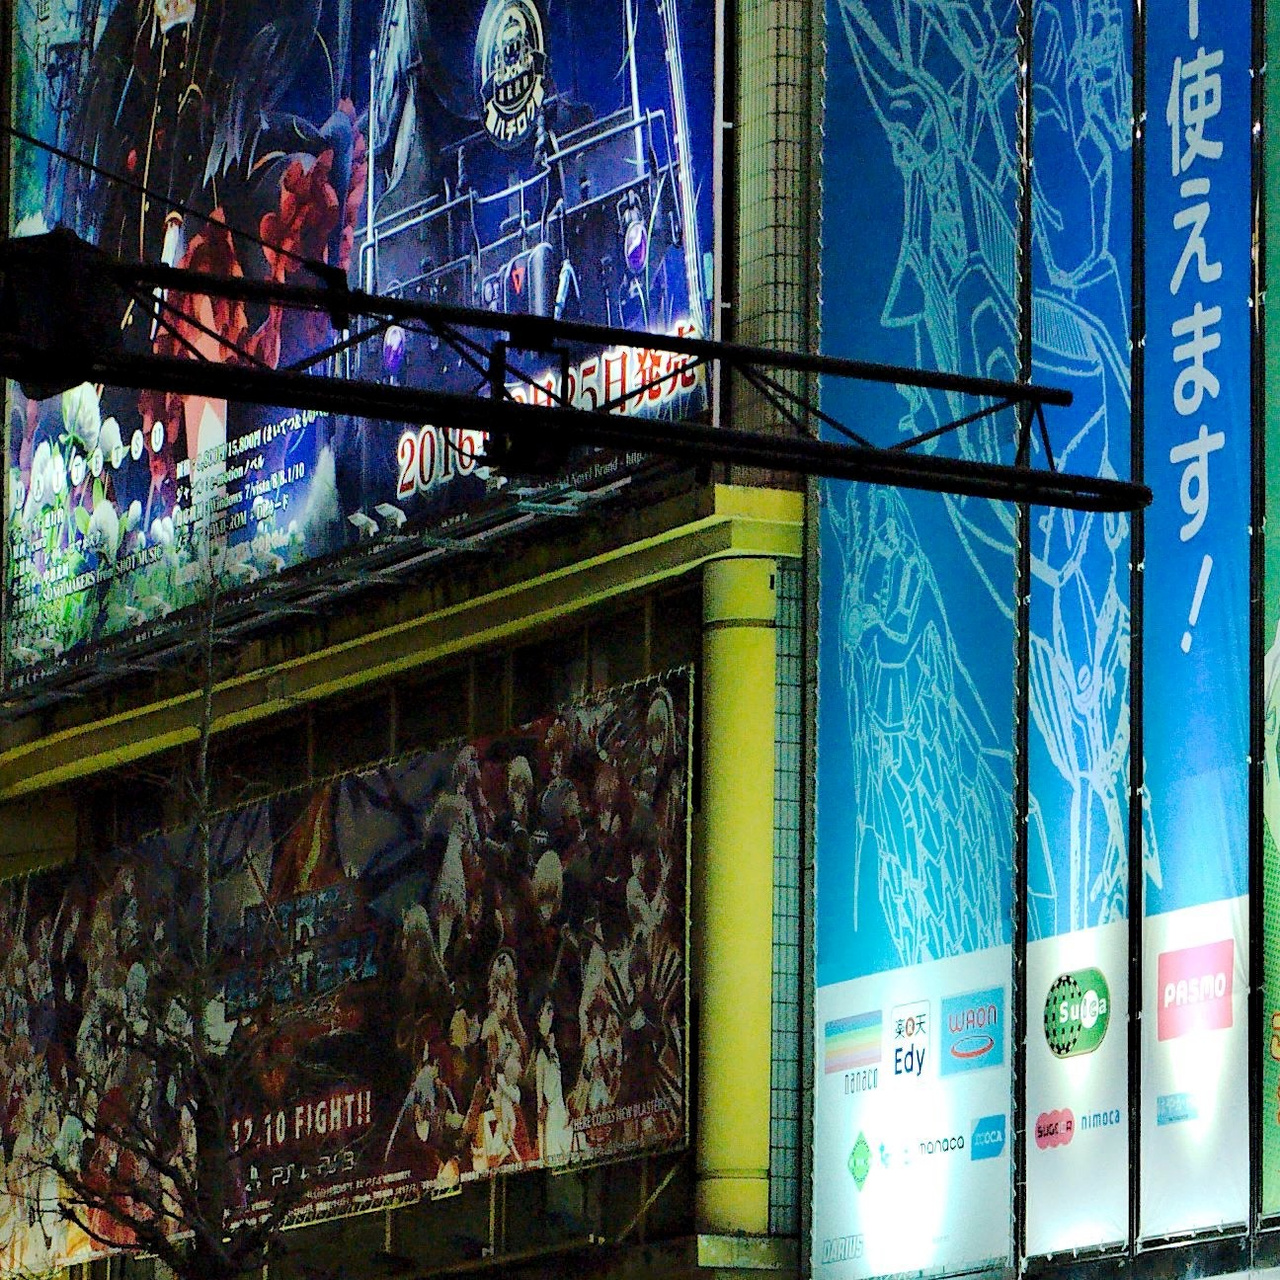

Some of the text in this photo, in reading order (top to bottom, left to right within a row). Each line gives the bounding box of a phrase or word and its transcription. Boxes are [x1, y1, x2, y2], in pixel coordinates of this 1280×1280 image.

[1163, 972, 1227, 1009] PASMO
[894, 1043, 926, 1077] Edy
[1081, 1108, 1121, 1131] nimoca
